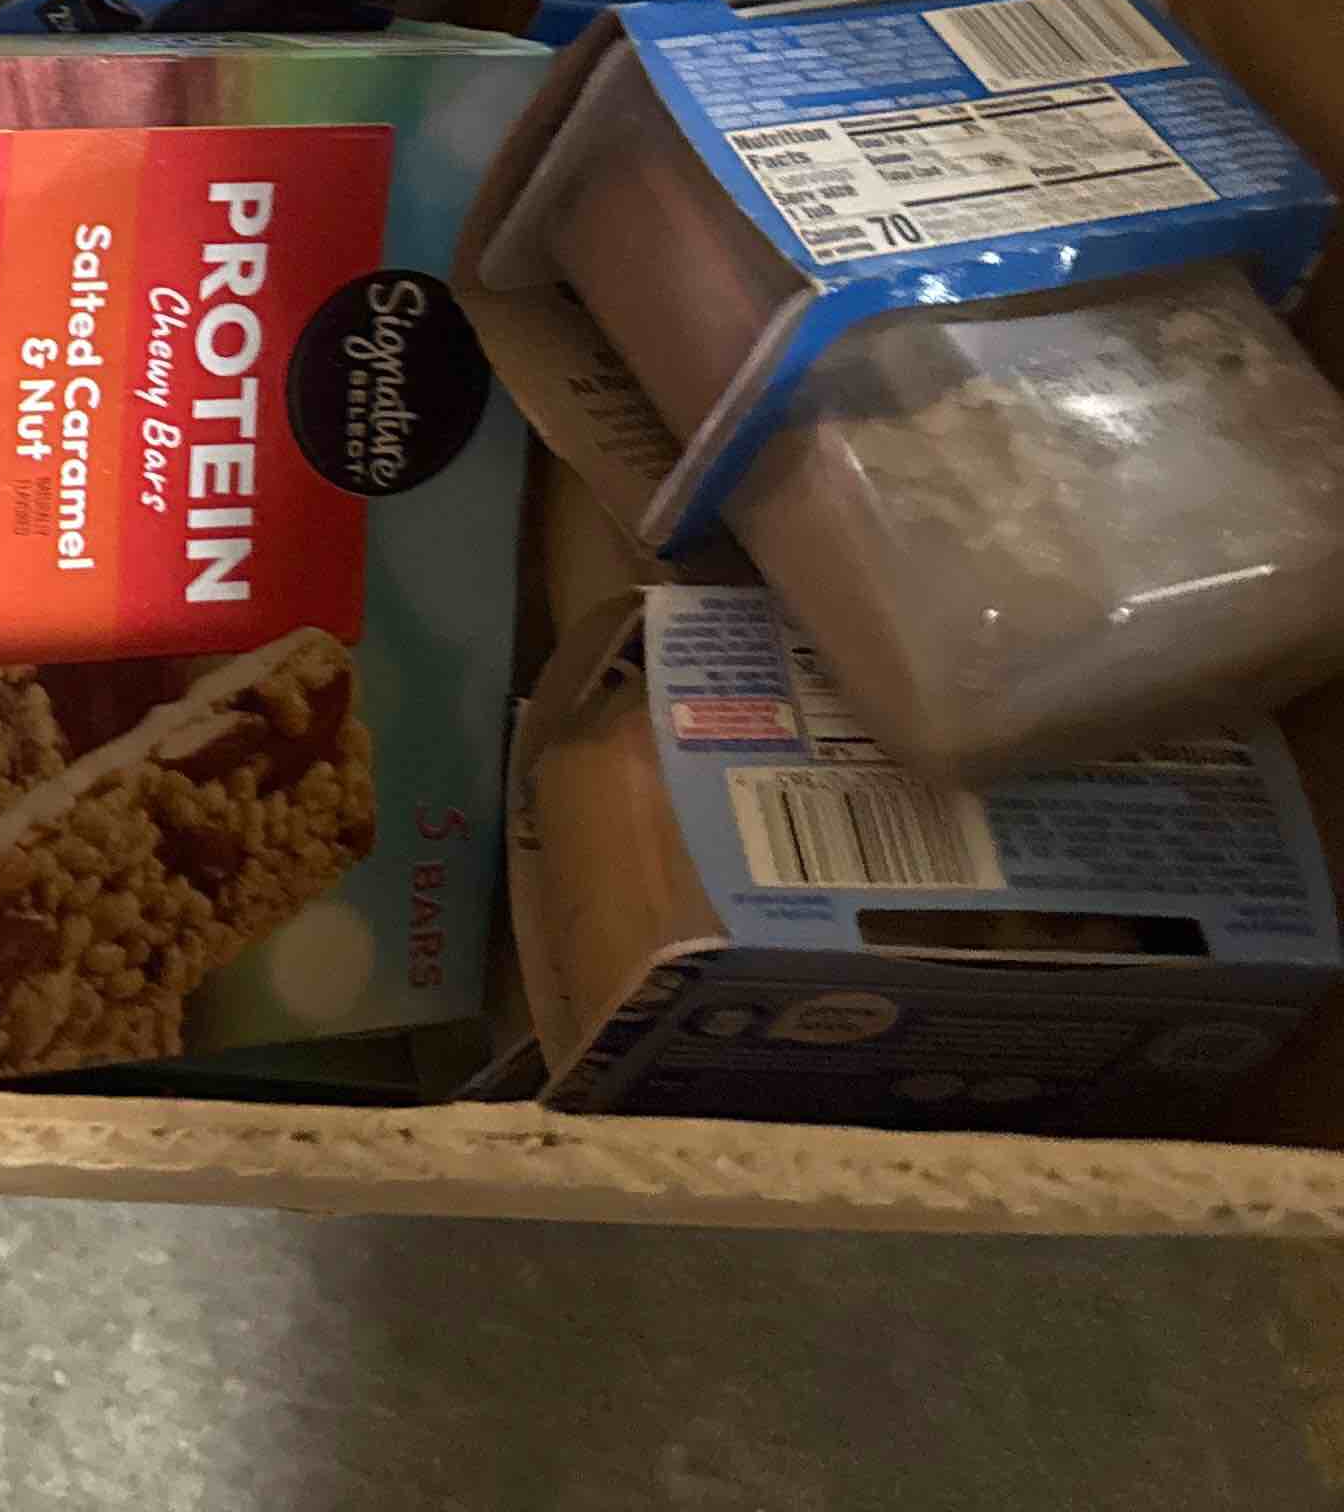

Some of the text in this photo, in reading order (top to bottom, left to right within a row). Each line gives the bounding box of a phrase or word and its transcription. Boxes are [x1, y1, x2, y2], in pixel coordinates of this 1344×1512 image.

[732, 126, 830, 155] Nutrition
[748, 149, 811, 170] Facts
[871, 215, 923, 247] 70
[13, 336, 56, 461] & Nut
[56, 222, 112, 572] Salted Caramel
[132, 285, 192, 514] Chewy Bars
[180, 176, 275, 608] PROTEIN
[343, 276, 427, 494] Signature
[343, 367, 367, 474] SELECT
[407, 804, 471, 991] 5 BARS
